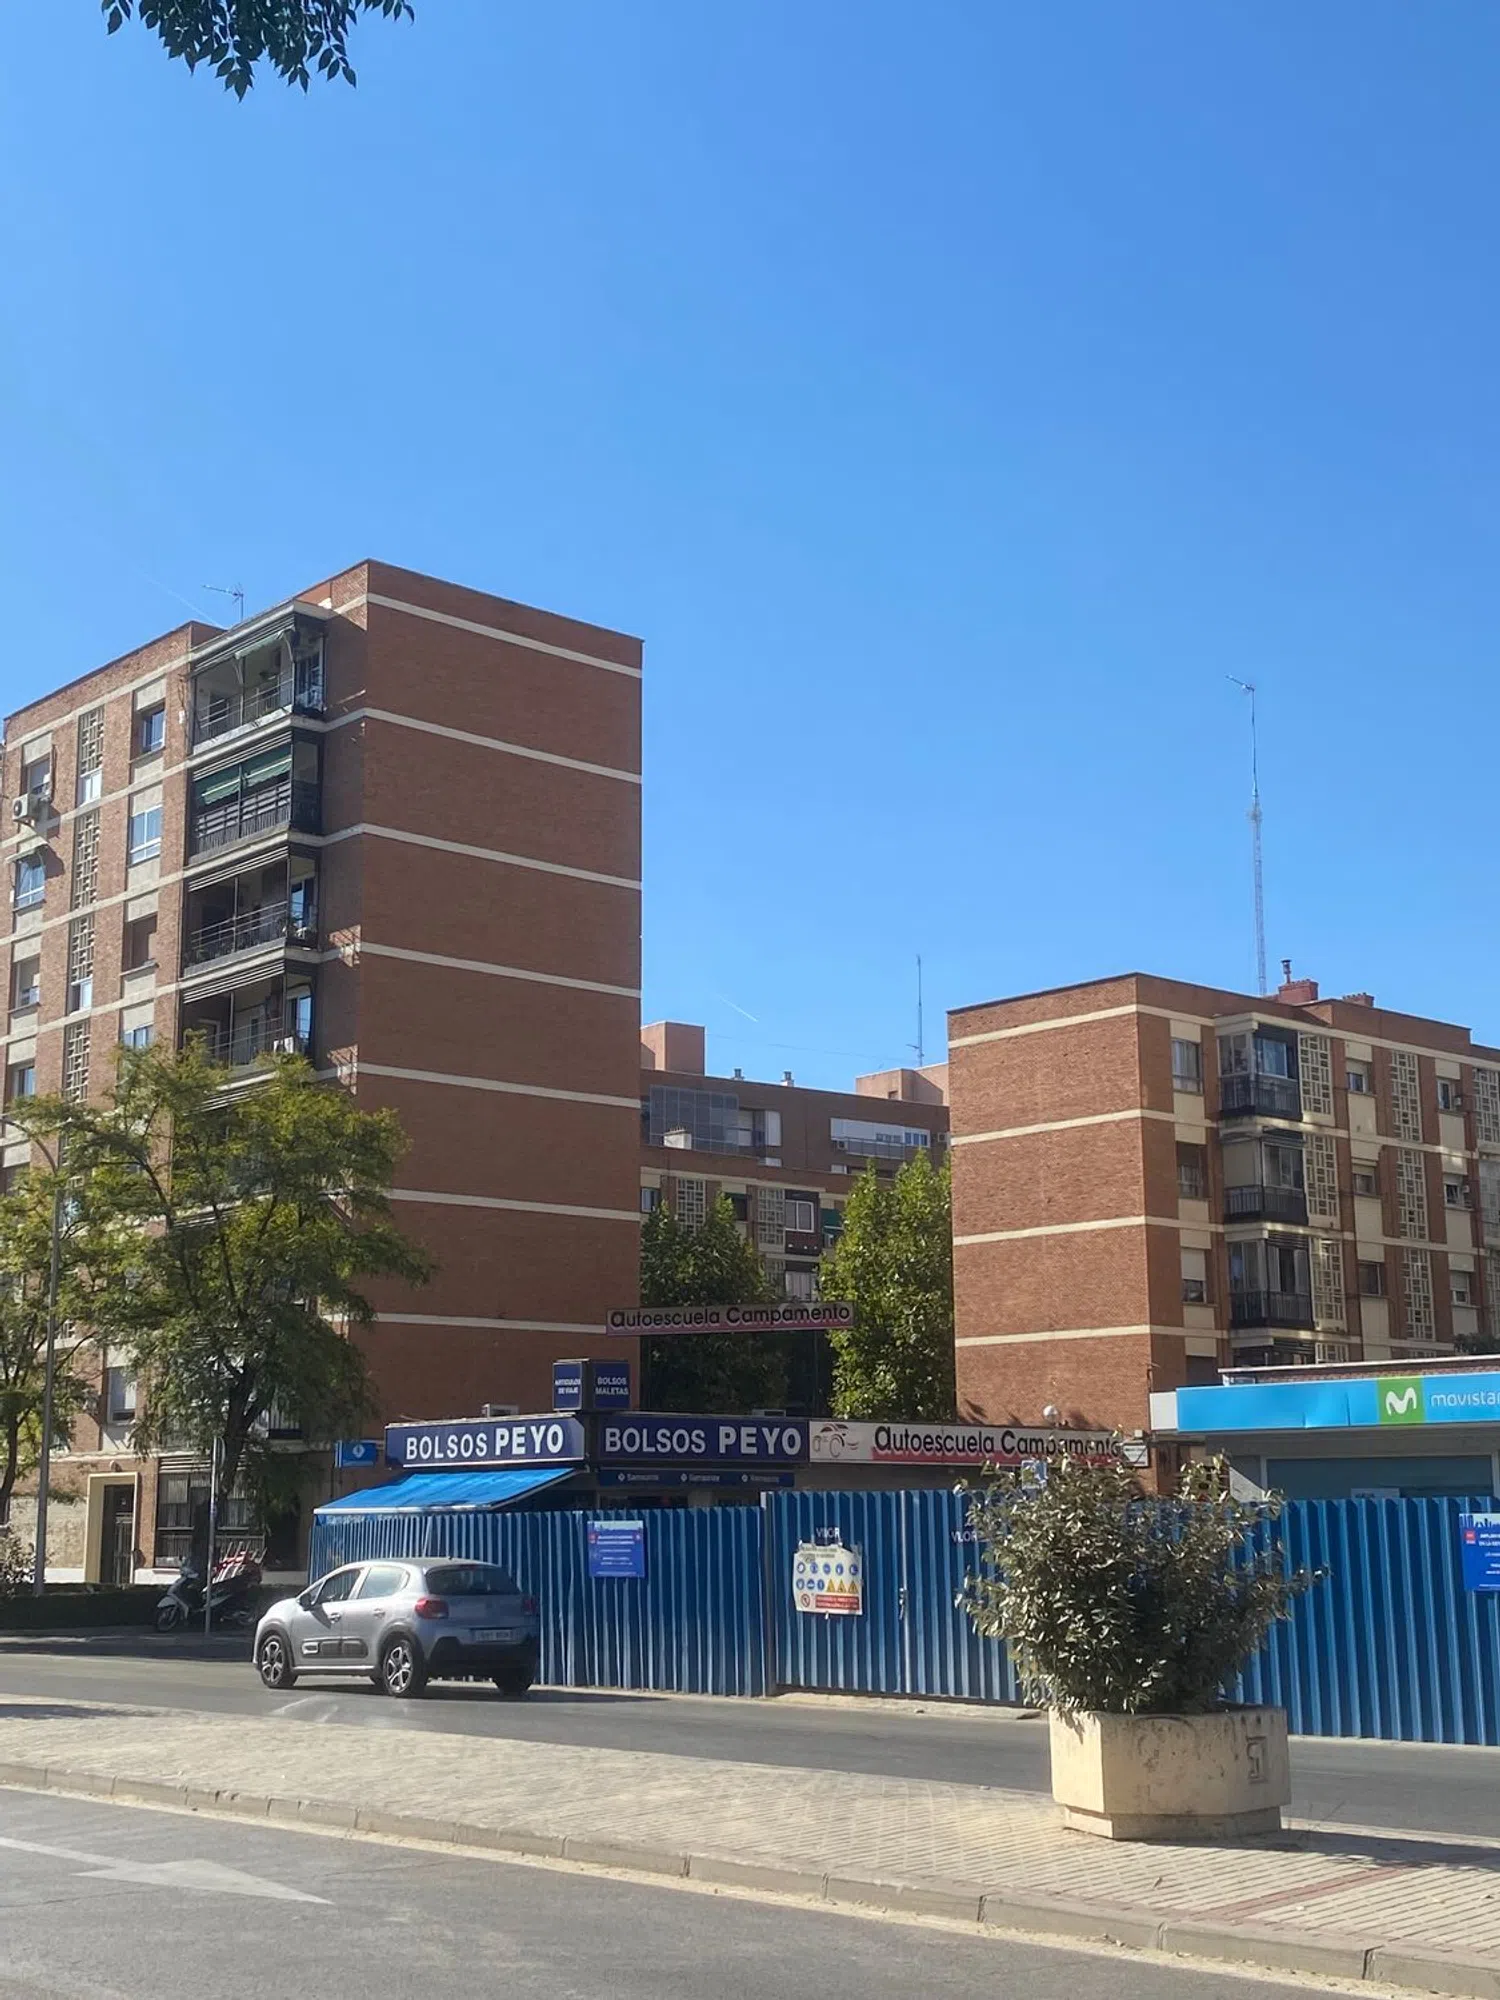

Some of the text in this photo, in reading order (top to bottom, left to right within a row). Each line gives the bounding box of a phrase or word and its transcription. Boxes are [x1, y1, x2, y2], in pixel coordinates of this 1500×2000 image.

[726, 1304, 851, 1326] Campamento
[595, 1387, 629, 1395] MALETAS
[597, 1376, 627, 1385] BOLSOS
[406, 1424, 564, 1460] BOLSOS PEYO
[605, 1426, 801, 1456] BOLSOS PEYO
